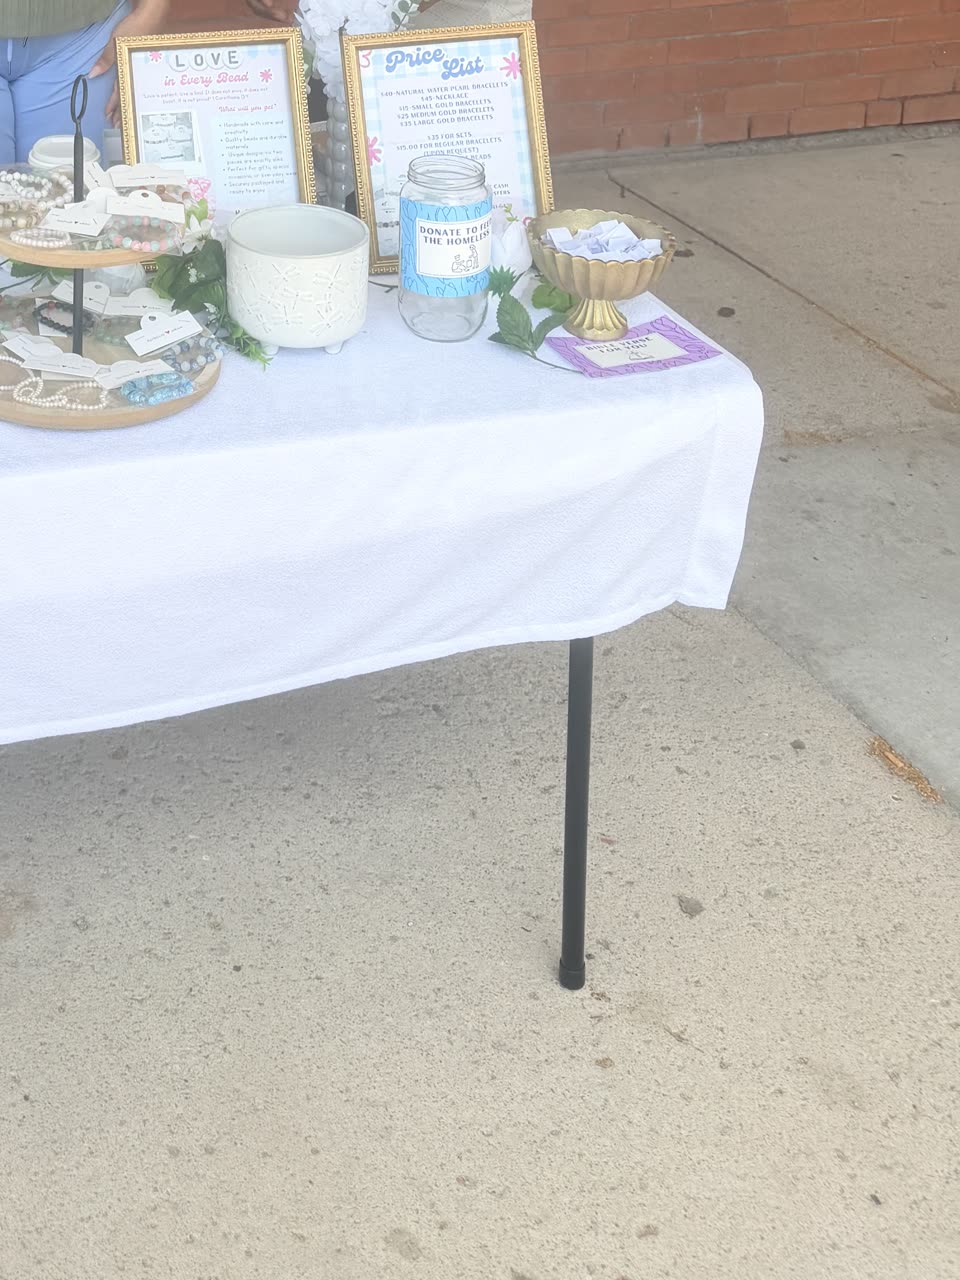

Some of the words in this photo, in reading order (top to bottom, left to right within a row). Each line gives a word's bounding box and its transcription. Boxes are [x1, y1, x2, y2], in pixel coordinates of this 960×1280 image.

[176, 50, 238, 68] LOVE
[386, 48, 444, 72] Price
[441, 56, 484, 80] List
[164, 76, 176, 86] in
[180, 74, 212, 87] Every
[216, 72, 248, 84] Bead
[472, 82, 508, 90] BRACELETS
[459, 106, 494, 114] BRACELETS
[457, 114, 494, 122] BRACELETS
[466, 137, 502, 145] BRACELETS
[420, 226, 461, 236] DONATE
[466, 226, 478, 235] TO
[424, 236, 442, 245] THE
[447, 228, 490, 246] HOMELESS
[618, 337, 653, 346] VERSE
